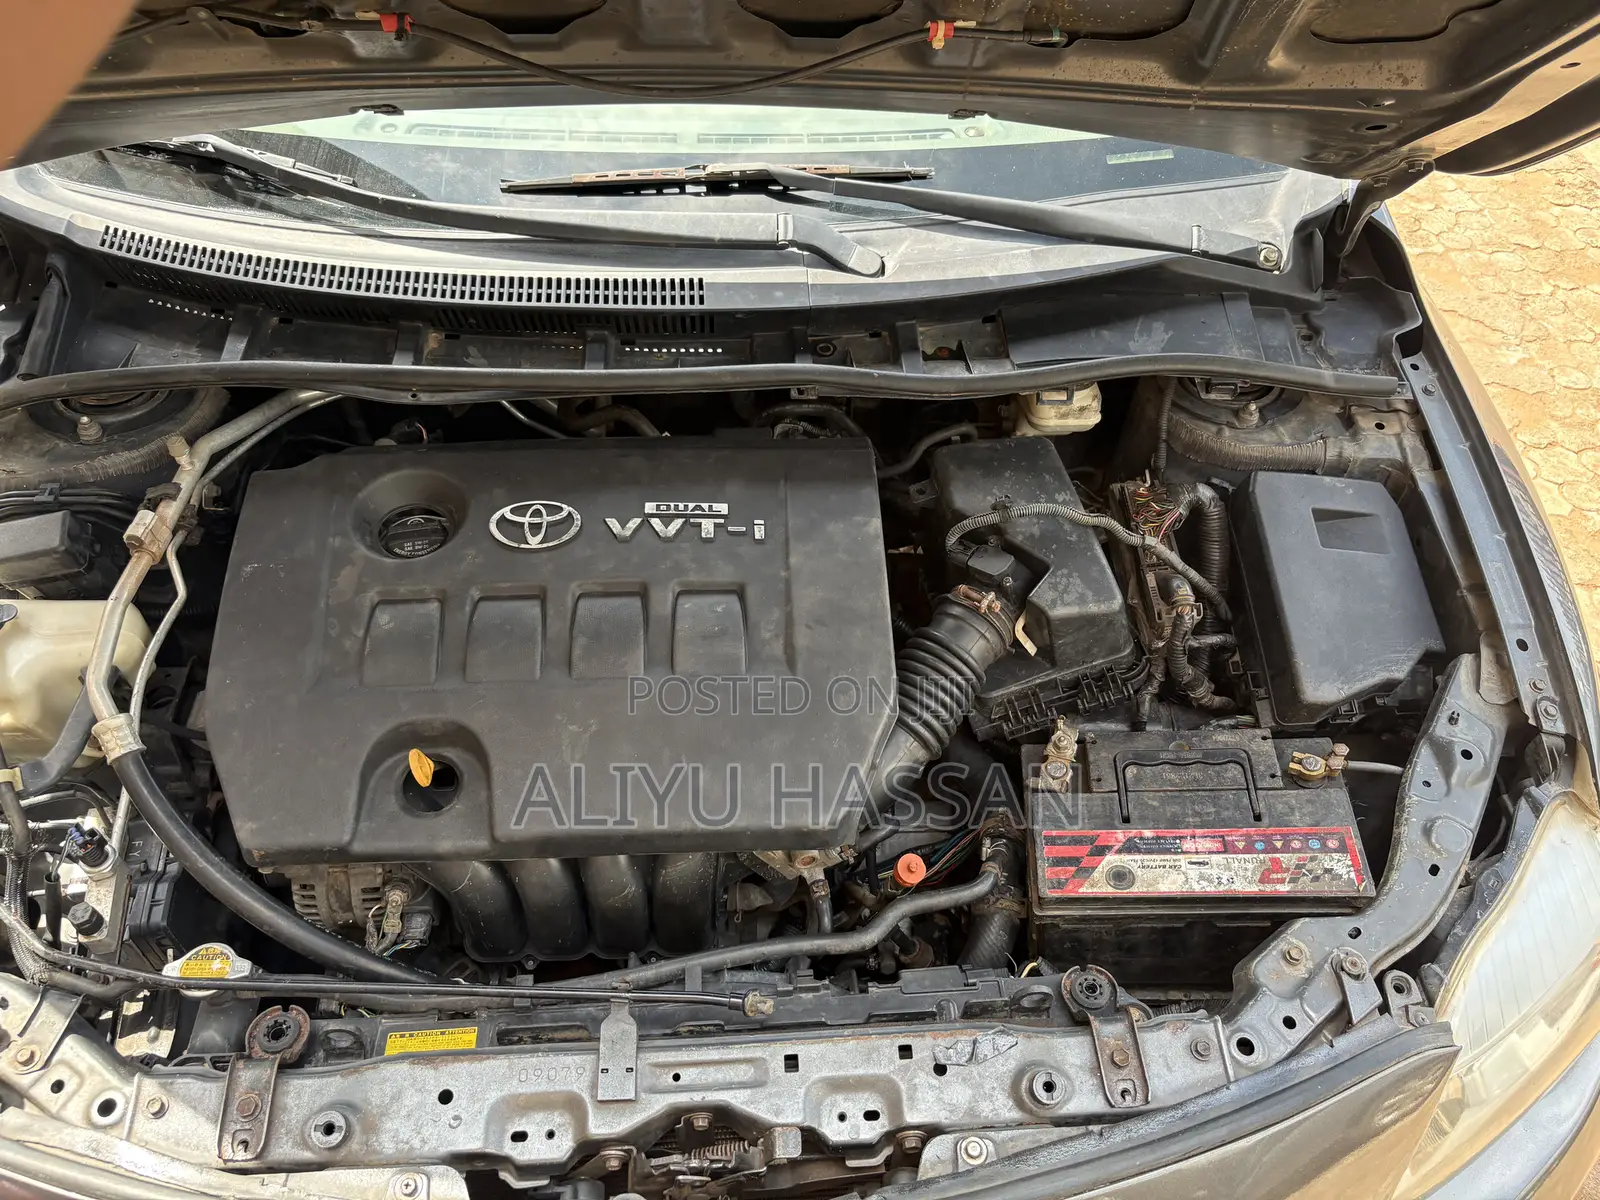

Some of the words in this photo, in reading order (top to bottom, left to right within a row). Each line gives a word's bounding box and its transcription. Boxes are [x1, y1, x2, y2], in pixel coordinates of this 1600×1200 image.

[654, 503, 723, 513] DUAL
[603, 517, 765, 542] VVT-i
[1222, 857, 1265, 865] RUNALL
[518, 1066, 586, 1082] 09079
